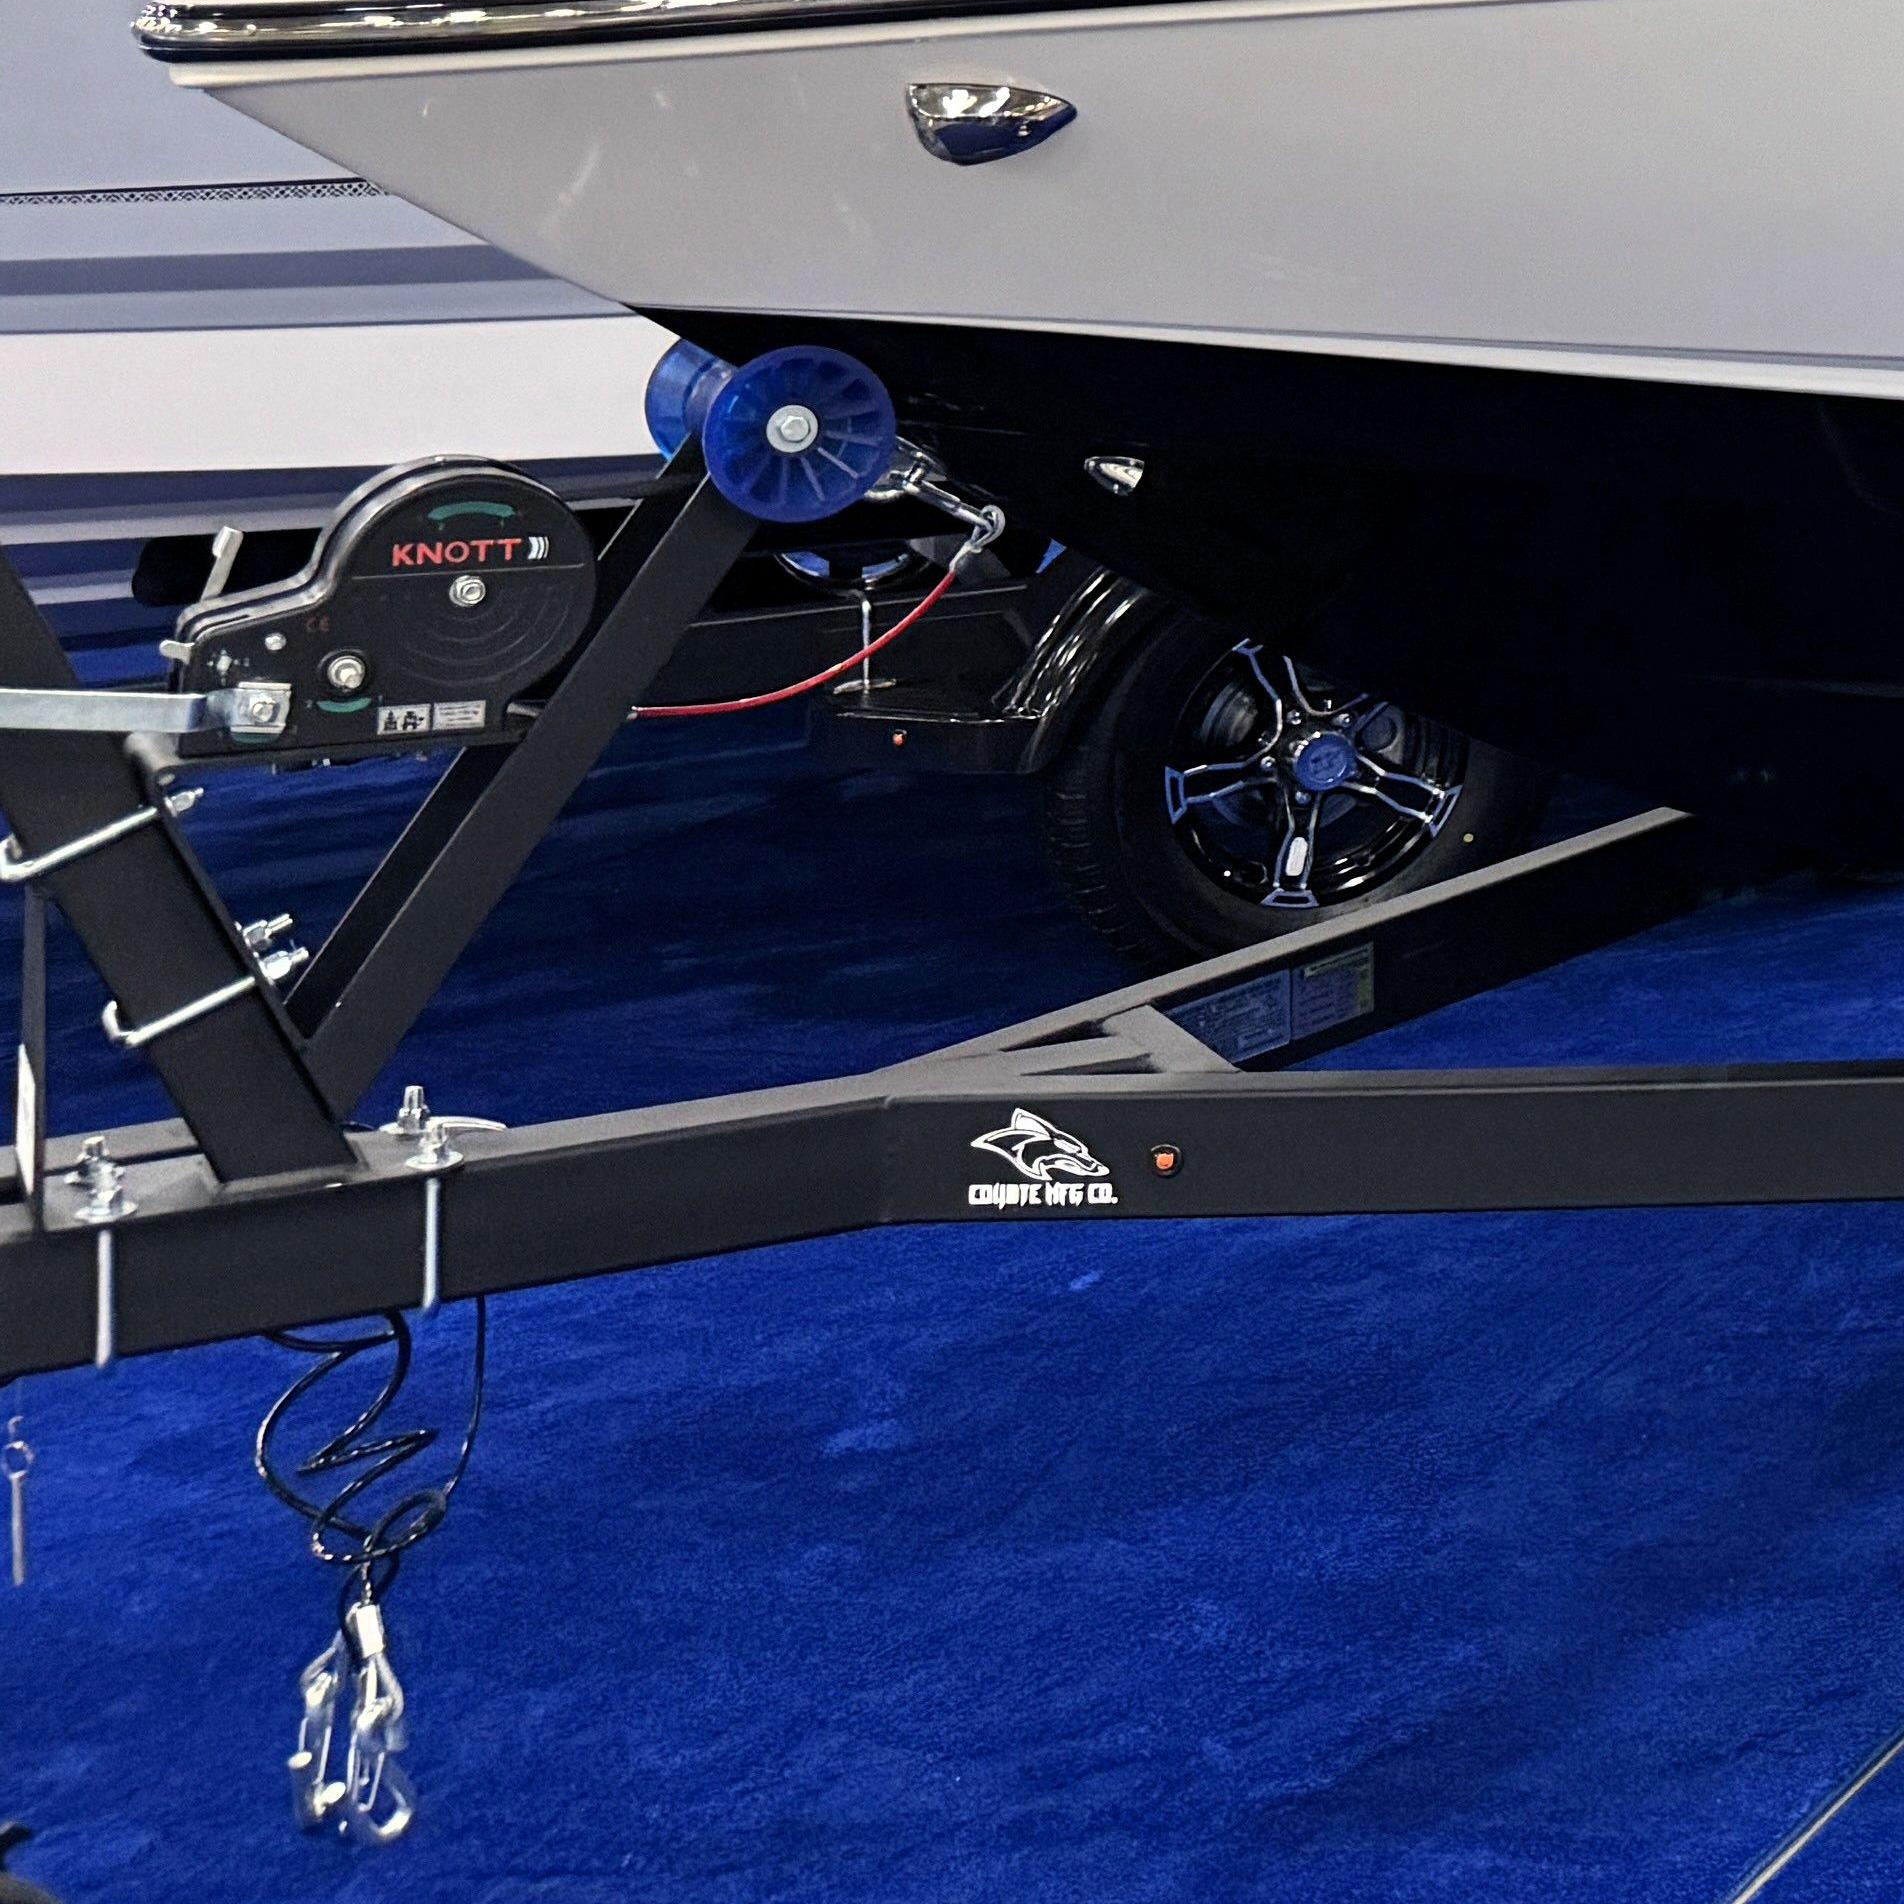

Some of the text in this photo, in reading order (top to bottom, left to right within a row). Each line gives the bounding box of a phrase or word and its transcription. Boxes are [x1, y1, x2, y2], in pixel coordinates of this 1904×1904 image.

[391, 537, 522, 568] KNOTT
[968, 1182, 1042, 1210] COYOTE
[1087, 1182, 1119, 1205] CO.
